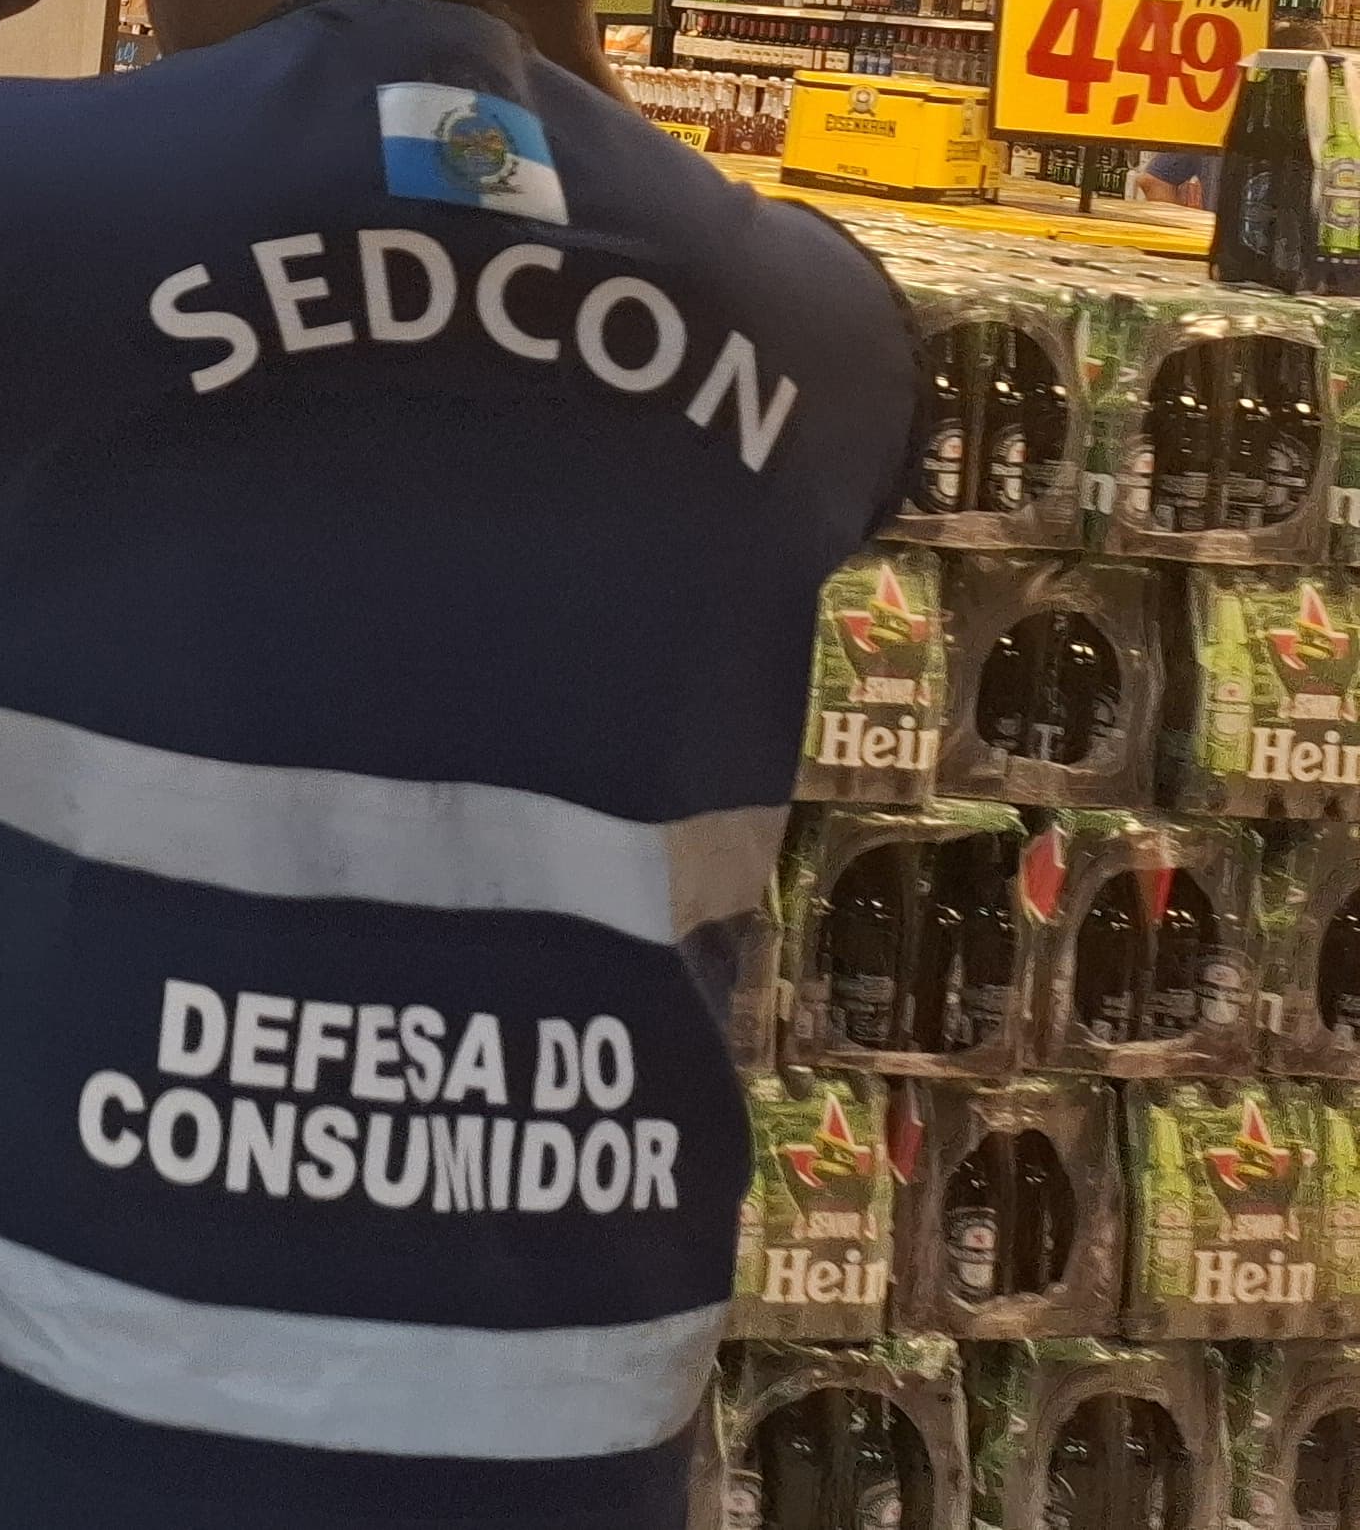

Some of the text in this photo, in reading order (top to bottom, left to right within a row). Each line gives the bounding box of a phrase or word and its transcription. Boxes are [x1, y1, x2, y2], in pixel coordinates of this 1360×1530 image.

[148, 229, 800, 474] SEDCON
[157, 978, 635, 1113] DEFESA DO
[78, 1070, 680, 1214] CONSUMIDOR
